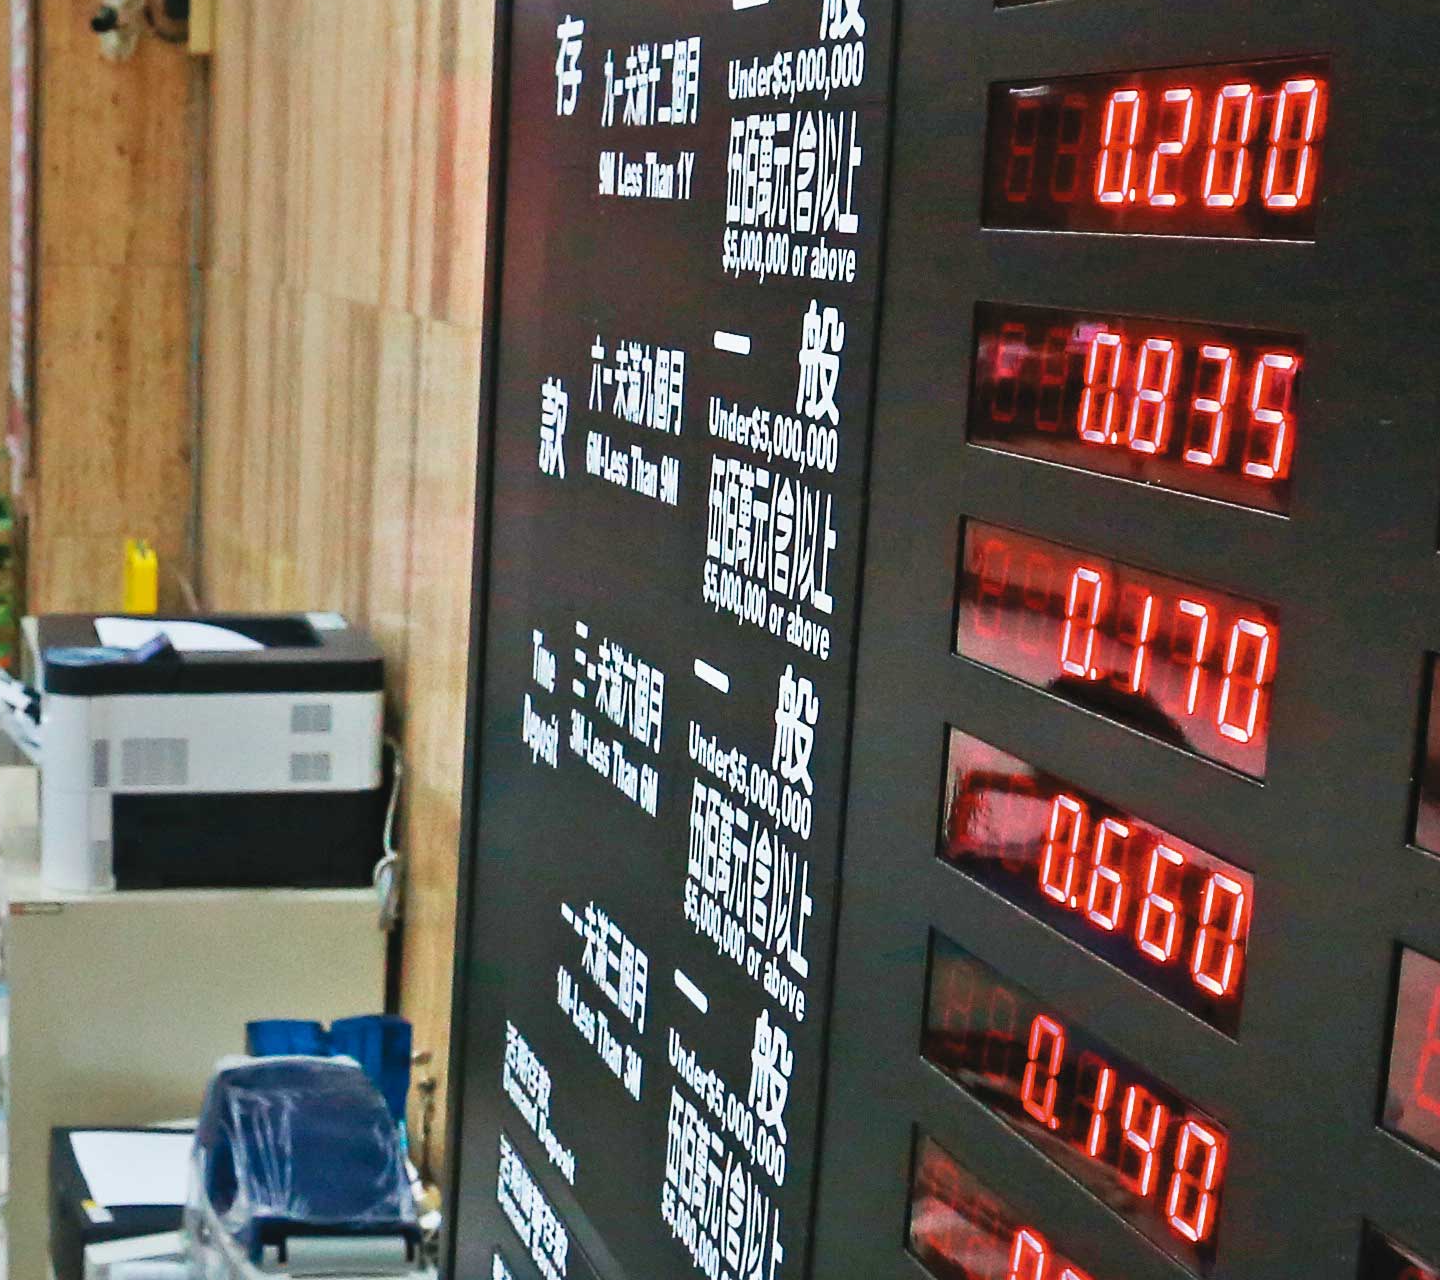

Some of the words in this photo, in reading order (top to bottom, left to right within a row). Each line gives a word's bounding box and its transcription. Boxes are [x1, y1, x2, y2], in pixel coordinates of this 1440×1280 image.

[728, 42, 865, 102] Under$5,000,000
[599, 151, 616, 195] 9M
[617, 151, 643, 197] Less
[645, 151, 674, 199] Than
[677, 151, 695, 200] 1Y
[1096, 78, 1319, 208] 0.200
[723, 227, 789, 285] $5,000,000
[791, 240, 807, 272] or
[810, 242, 856, 284] above
[708, 396, 839, 473] Under$5,000,000
[1079, 331, 1298, 479] 0.835
[585, 430, 629, 486] 6M-Less
[631, 445, 658, 498] Than
[659, 456, 679, 506] 9M
[532, 628, 557, 694] Time
[703, 558, 768, 629] $5,000,000
[768, 600, 785, 634] or
[787, 607, 830, 661] above
[1061, 566, 1270, 743] 0.170
[522, 693, 559, 769] Deposit
[569, 708, 610, 778] 3M-Less
[612, 739, 639, 802] Than
[640, 763, 659, 818] 6M
[689, 721, 812, 840] Under$5,000,000
[683, 876, 745, 966] $5,000,000
[746, 946, 762, 980] or
[763, 956, 806, 1022] above
[1041, 794, 1245, 996] 0.660
[557, 964, 595, 1045] 1M-Less
[597, 1010, 622, 1079] Than
[623, 1044, 643, 1101] 3M
[668, 1027, 785, 1188] Under$5,000,000
[1022, 1014, 1218, 1242] 0.140
